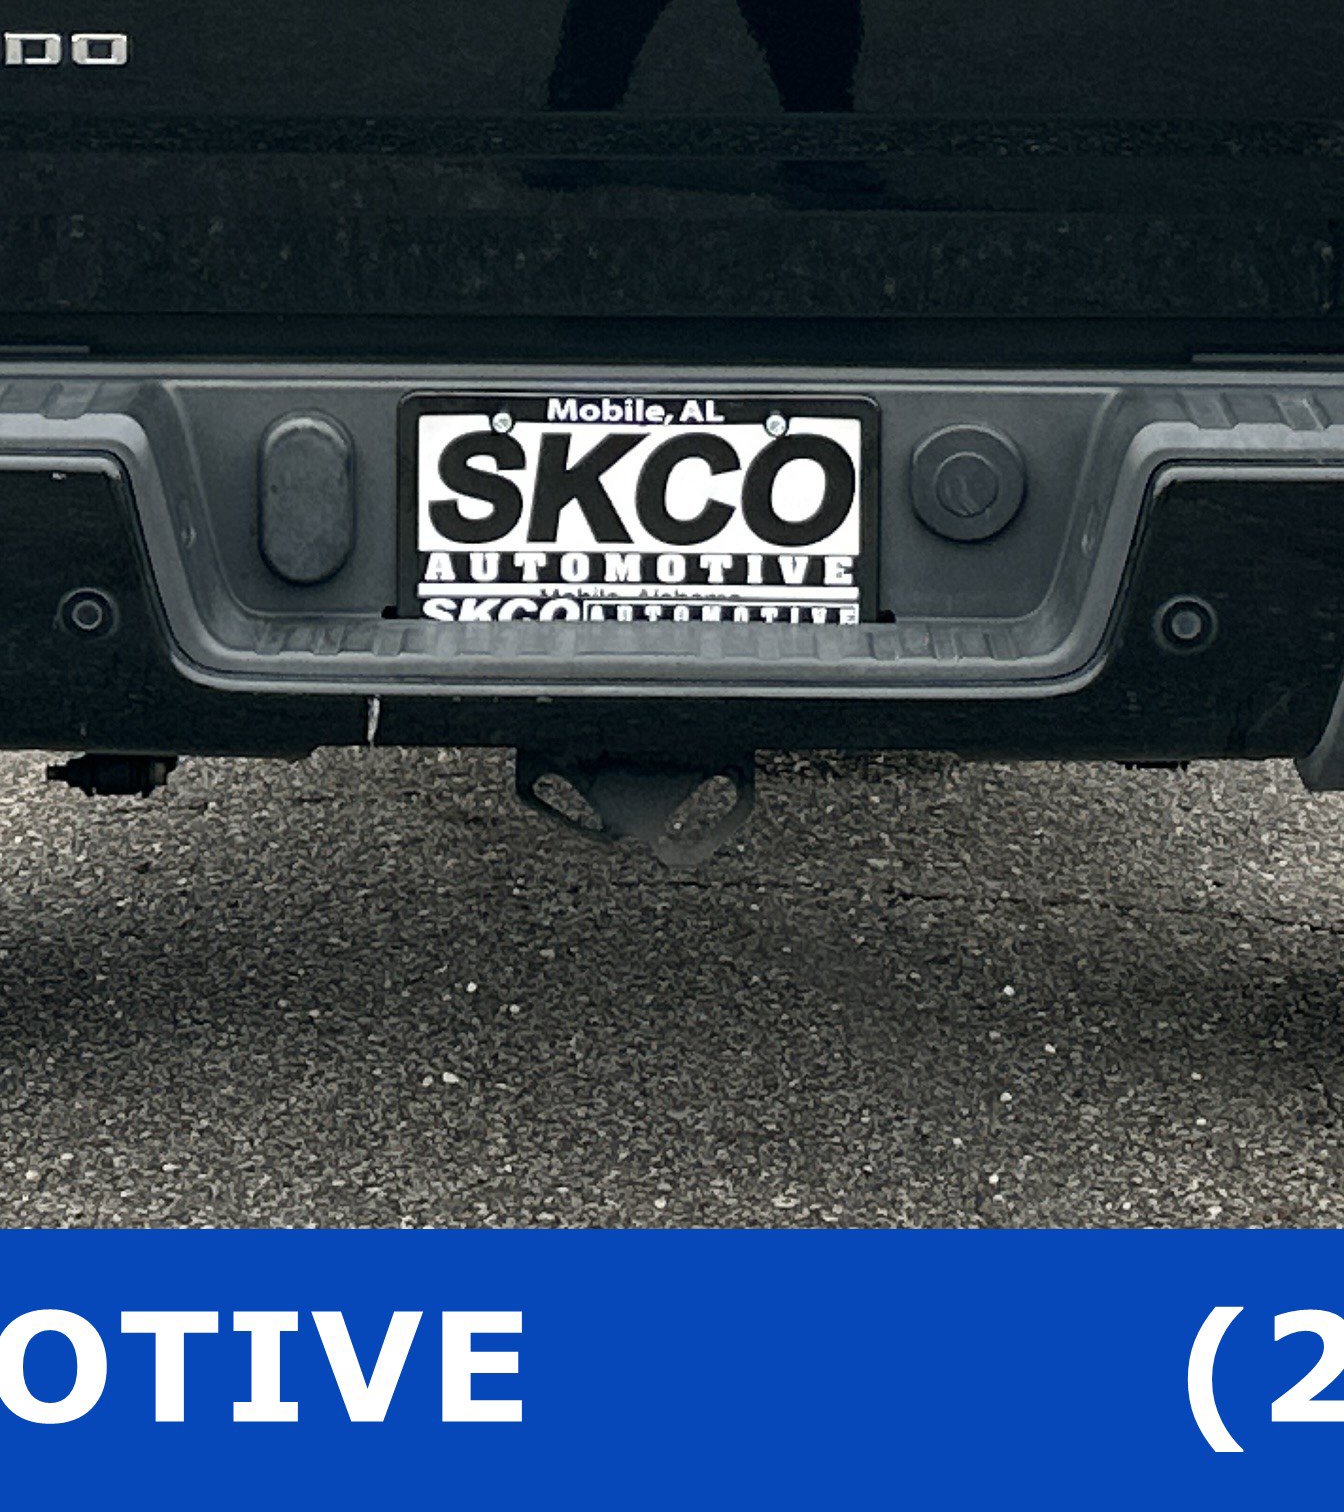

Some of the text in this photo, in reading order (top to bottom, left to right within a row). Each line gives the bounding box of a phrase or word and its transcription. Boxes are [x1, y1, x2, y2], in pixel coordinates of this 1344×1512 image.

[547, 398, 724, 426] Mobile, AL
[428, 430, 856, 547] SKCO
[424, 551, 854, 585] AUTOMOTIVE
[422, 598, 581, 622] SKCO
